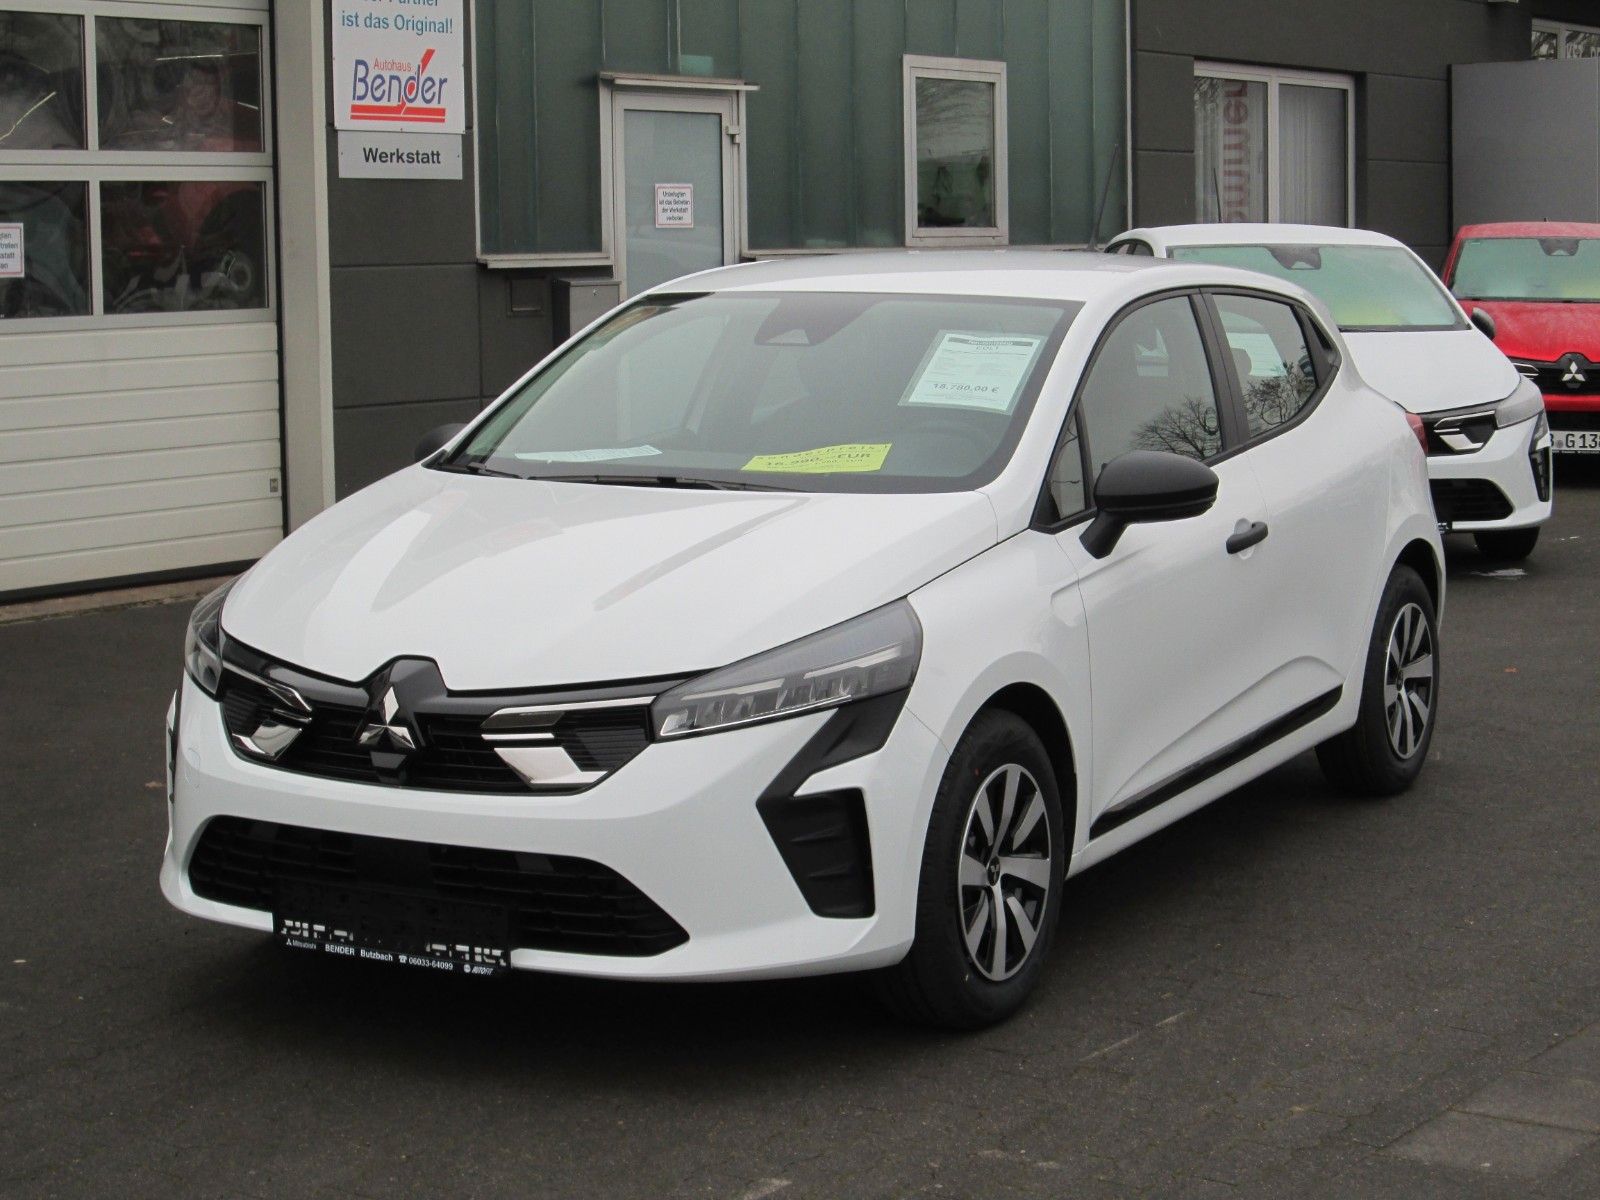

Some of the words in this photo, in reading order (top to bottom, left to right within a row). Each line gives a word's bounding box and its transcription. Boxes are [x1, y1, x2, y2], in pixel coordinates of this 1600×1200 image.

[342, 10, 359, 27] ist
[364, 12, 389, 29] das
[394, 14, 453, 36] Original!
[373, 58, 412, 72] Autohaus
[352, 59, 448, 104] Bender
[363, 147, 441, 165] Werkstatt
[325, 943, 355, 956] BENDER
[360, 949, 393, 962] Butzbach
[408, 956, 454, 971] 06033-64099
